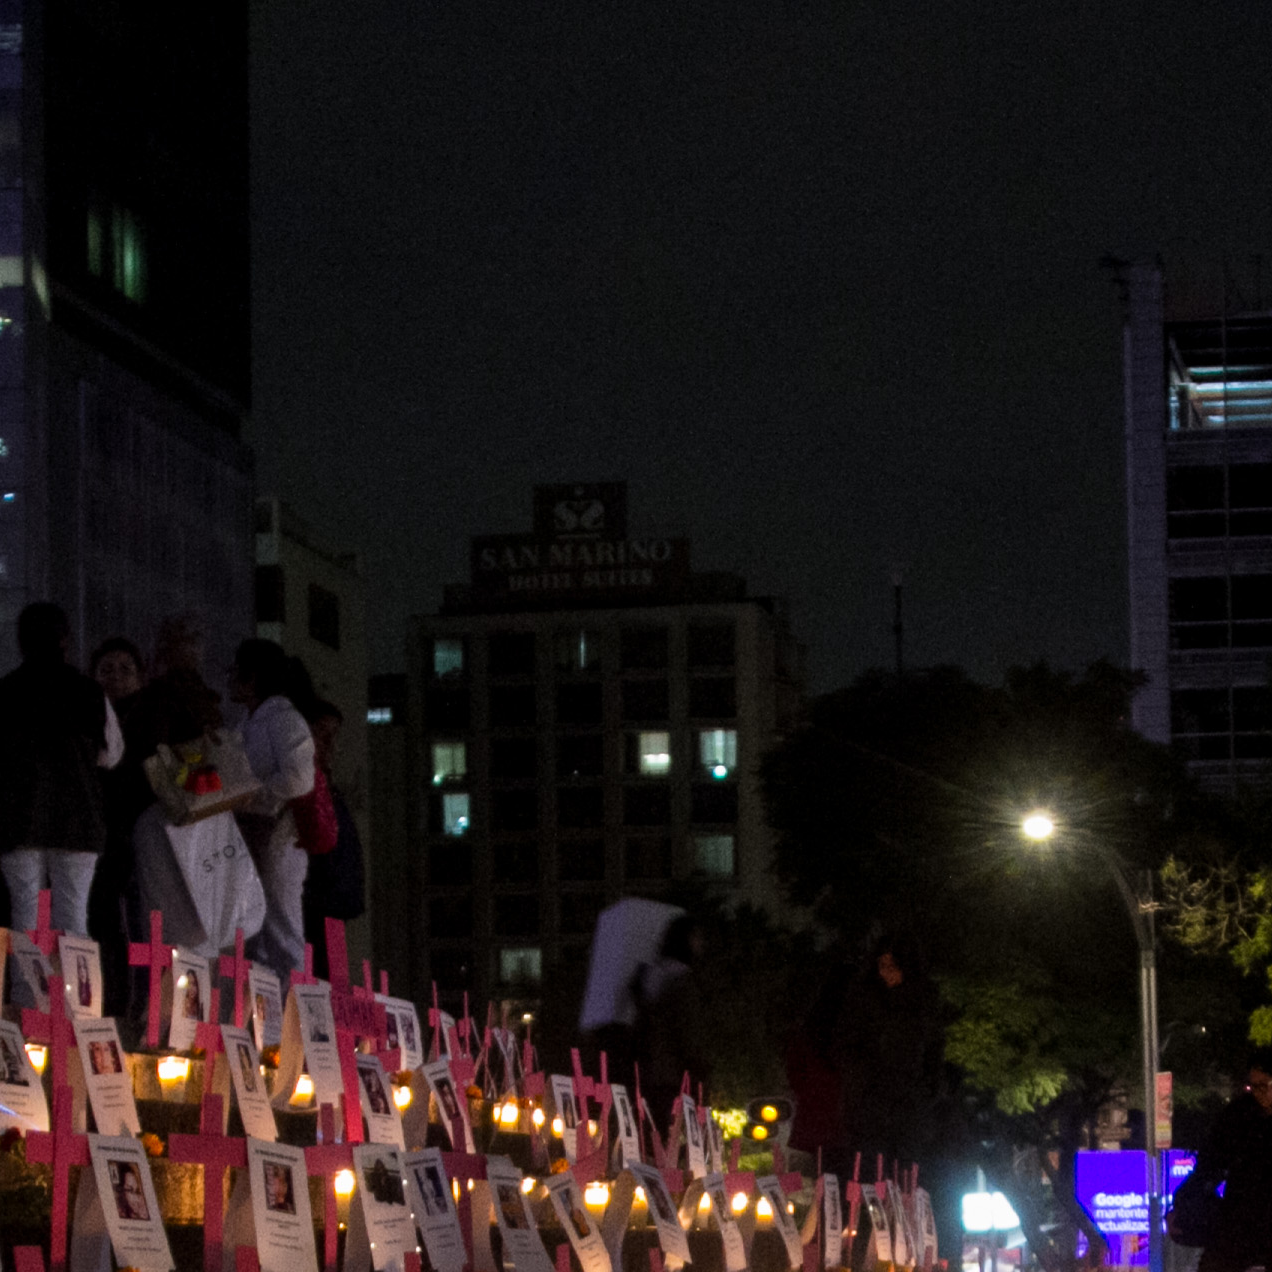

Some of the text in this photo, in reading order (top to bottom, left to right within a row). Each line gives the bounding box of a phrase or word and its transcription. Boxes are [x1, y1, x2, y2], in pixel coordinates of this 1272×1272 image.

[480, 539, 672, 571] SAN MARINO
[1095, 1192, 1143, 1208] Google
[1095, 1208, 1149, 1219] mantente
